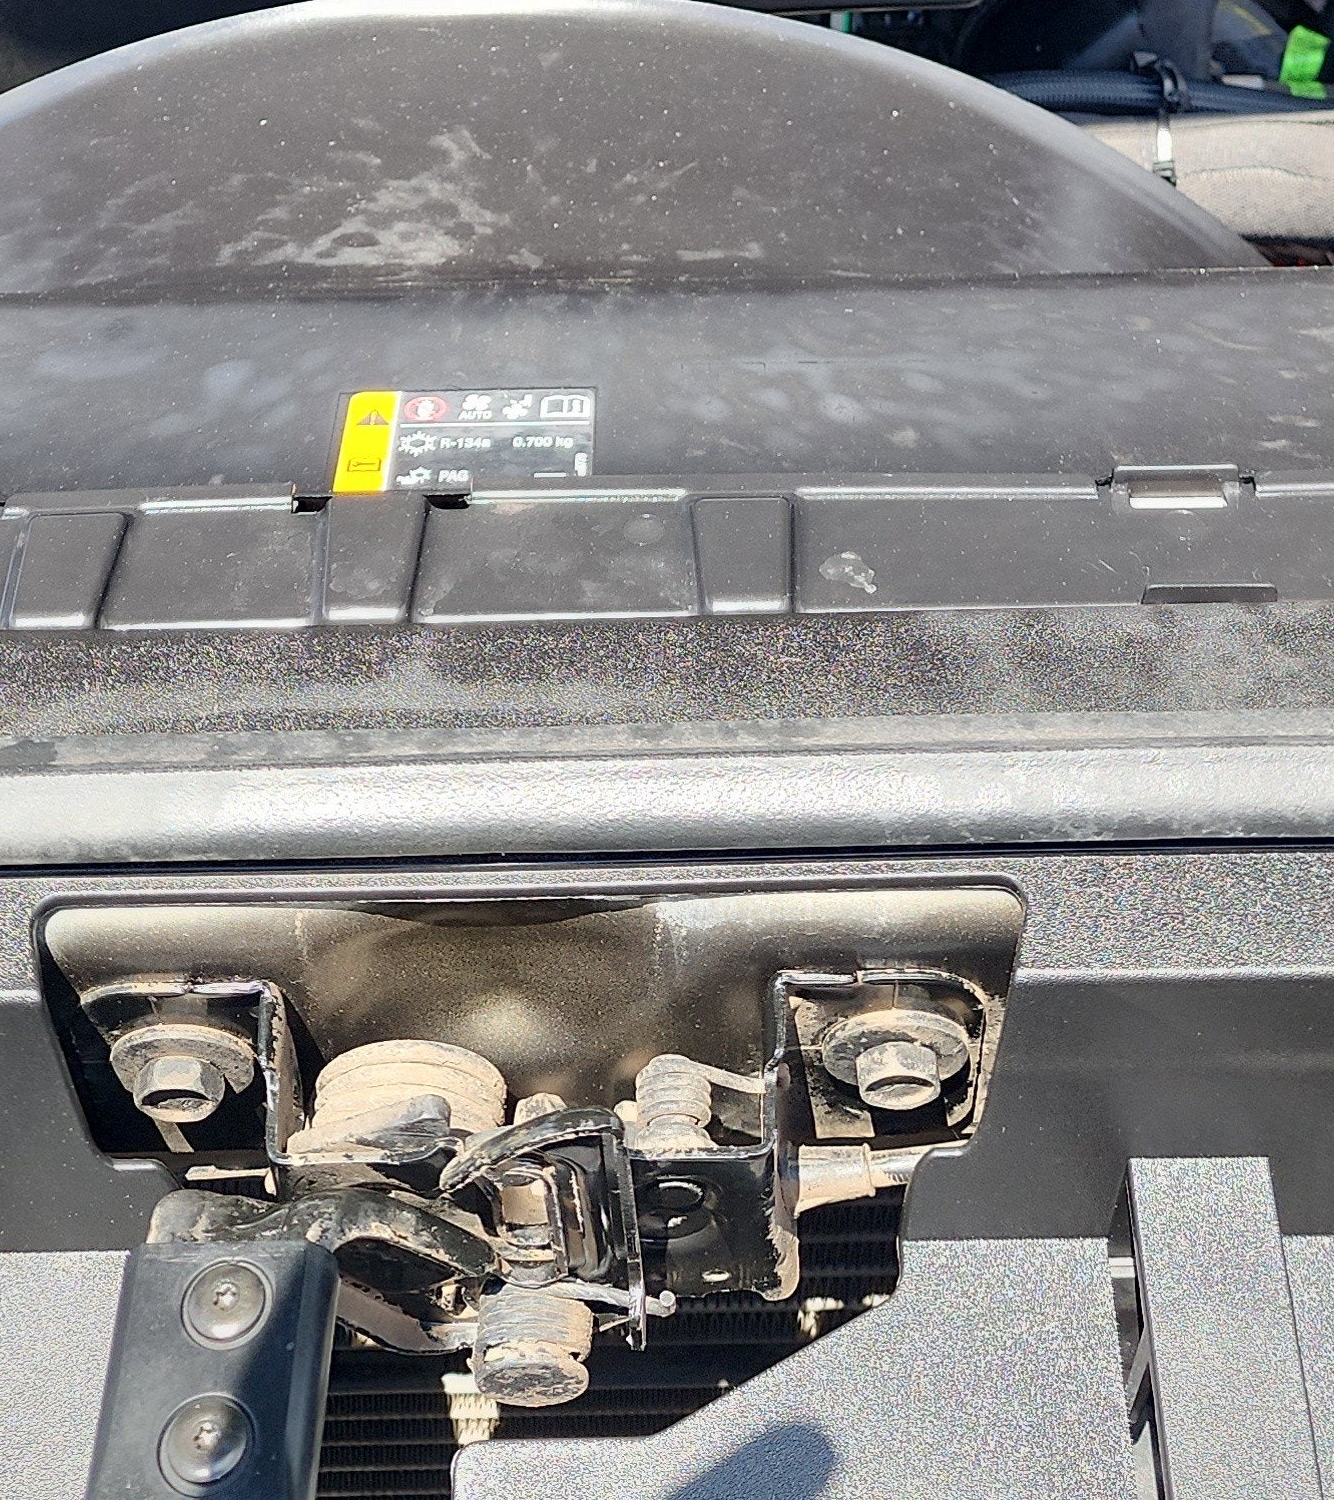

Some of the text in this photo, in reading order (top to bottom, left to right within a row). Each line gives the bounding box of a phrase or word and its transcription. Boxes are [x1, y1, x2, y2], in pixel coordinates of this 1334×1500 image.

[458, 410, 492, 420] AUTO
[439, 436, 574, 449] R-134a 0.700 kg
[438, 469, 469, 483] PAG
